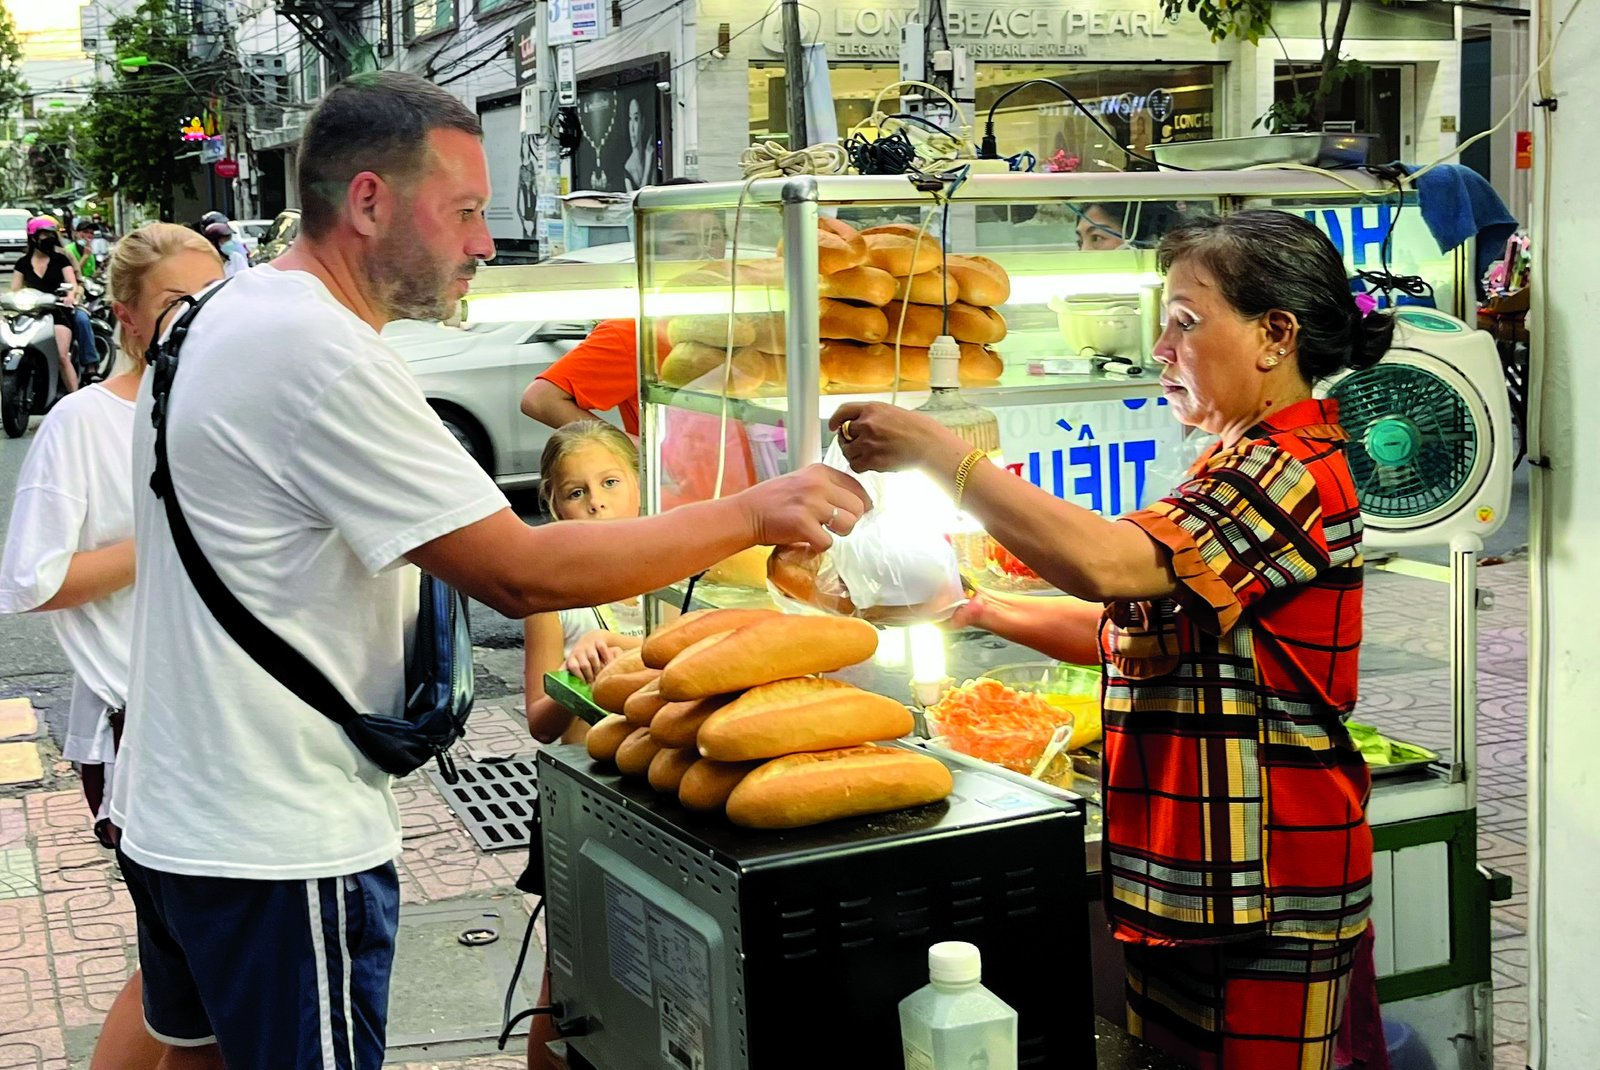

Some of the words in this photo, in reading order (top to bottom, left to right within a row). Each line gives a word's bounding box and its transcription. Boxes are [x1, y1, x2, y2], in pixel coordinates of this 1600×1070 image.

[947, 8, 1053, 37] BEACH
[1065, 8, 1168, 36] PEARL
[986, 44, 1026, 57] PEARL
[1174, 113, 1202, 129] LONG
